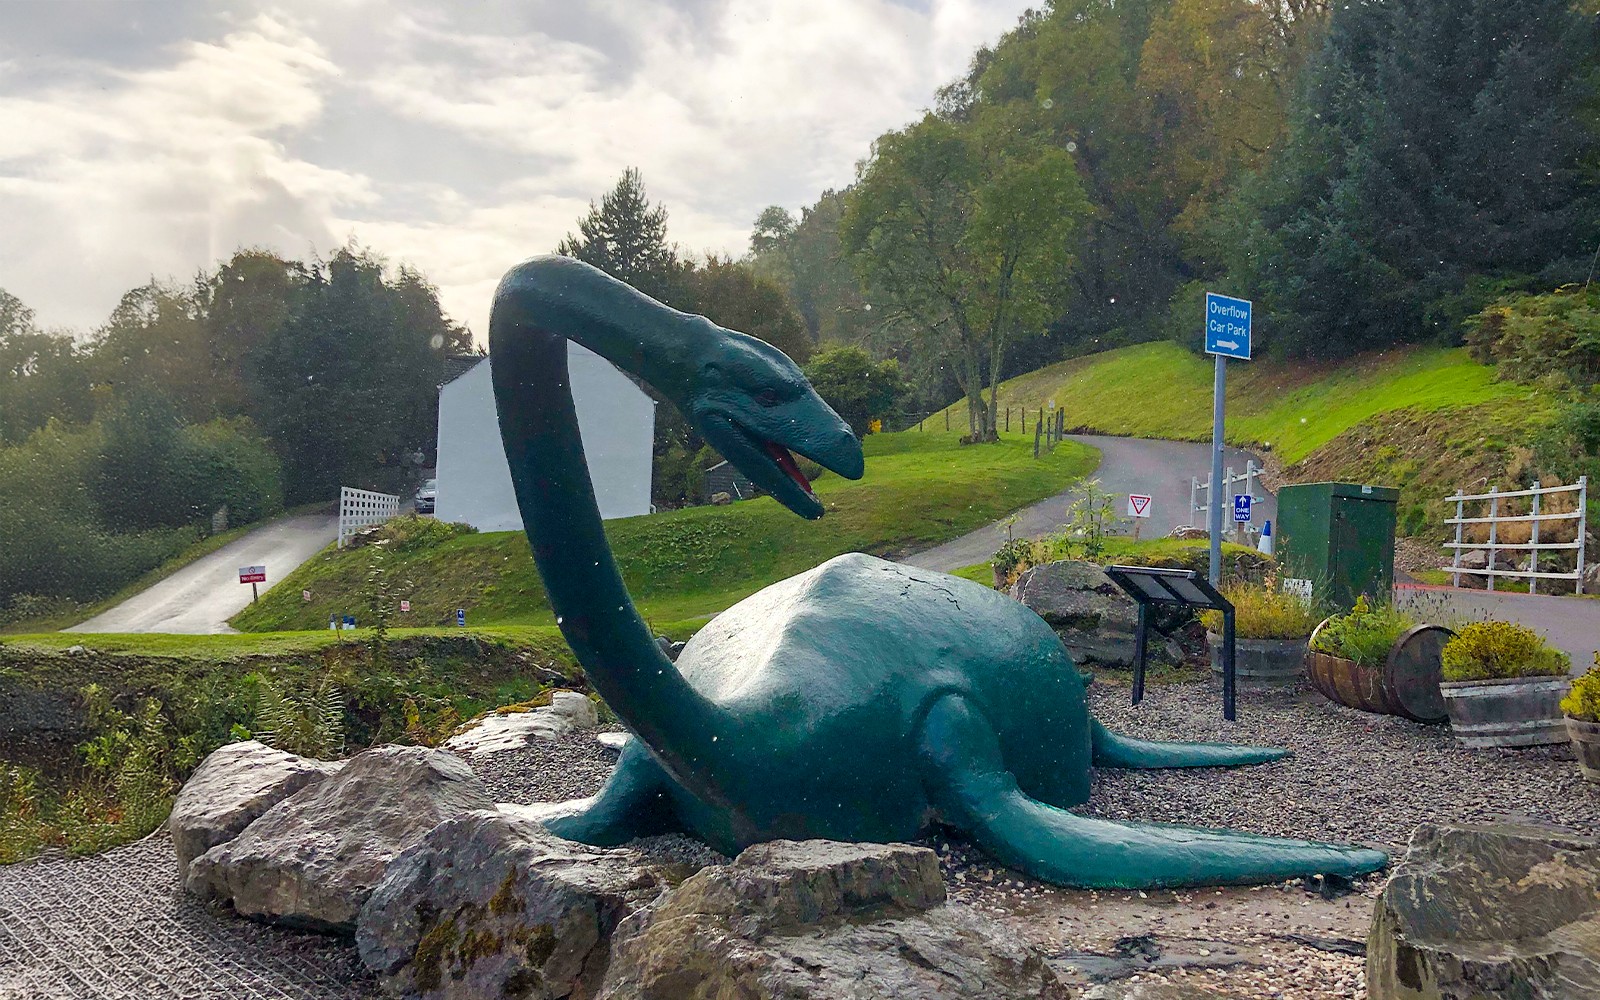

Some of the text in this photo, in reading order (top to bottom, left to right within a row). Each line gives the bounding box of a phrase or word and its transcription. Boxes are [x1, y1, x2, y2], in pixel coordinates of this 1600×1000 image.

[1210, 301, 1248, 320] Overflow
[1210, 319, 1247, 337] Car Park
